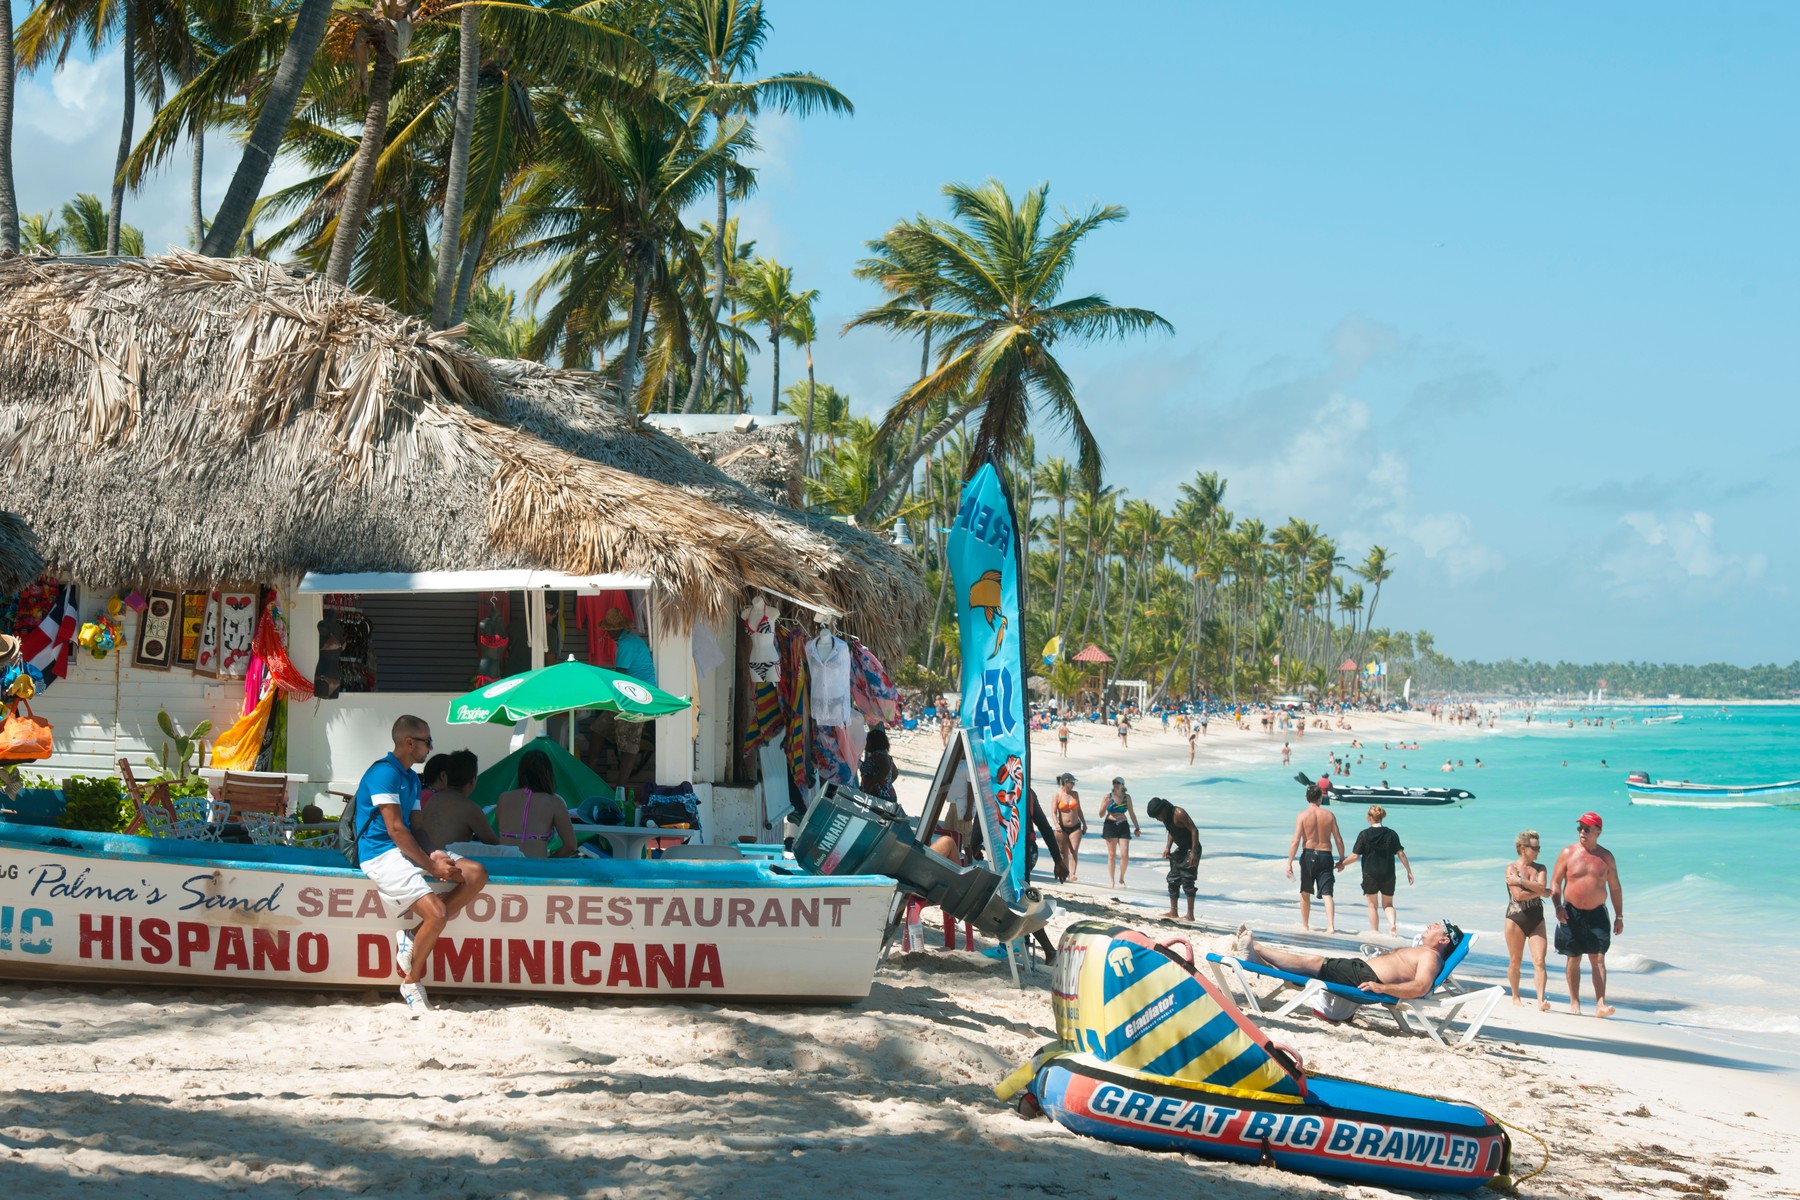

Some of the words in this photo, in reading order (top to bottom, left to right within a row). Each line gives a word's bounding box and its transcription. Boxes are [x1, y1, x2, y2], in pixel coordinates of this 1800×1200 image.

[818, 813, 849, 852] YAMAHA
[28, 863, 167, 905] Palma's
[178, 874, 285, 913] Sand
[545, 894, 852, 928] RESTAURANT
[79, 913, 330, 974] HISPANO
[1124, 993, 1175, 1039] Gladiator
[1091, 1082, 1240, 1139] GREAT
[1241, 1111, 1323, 1150] BIG
[1325, 1119, 1480, 1172] BRAWLER
